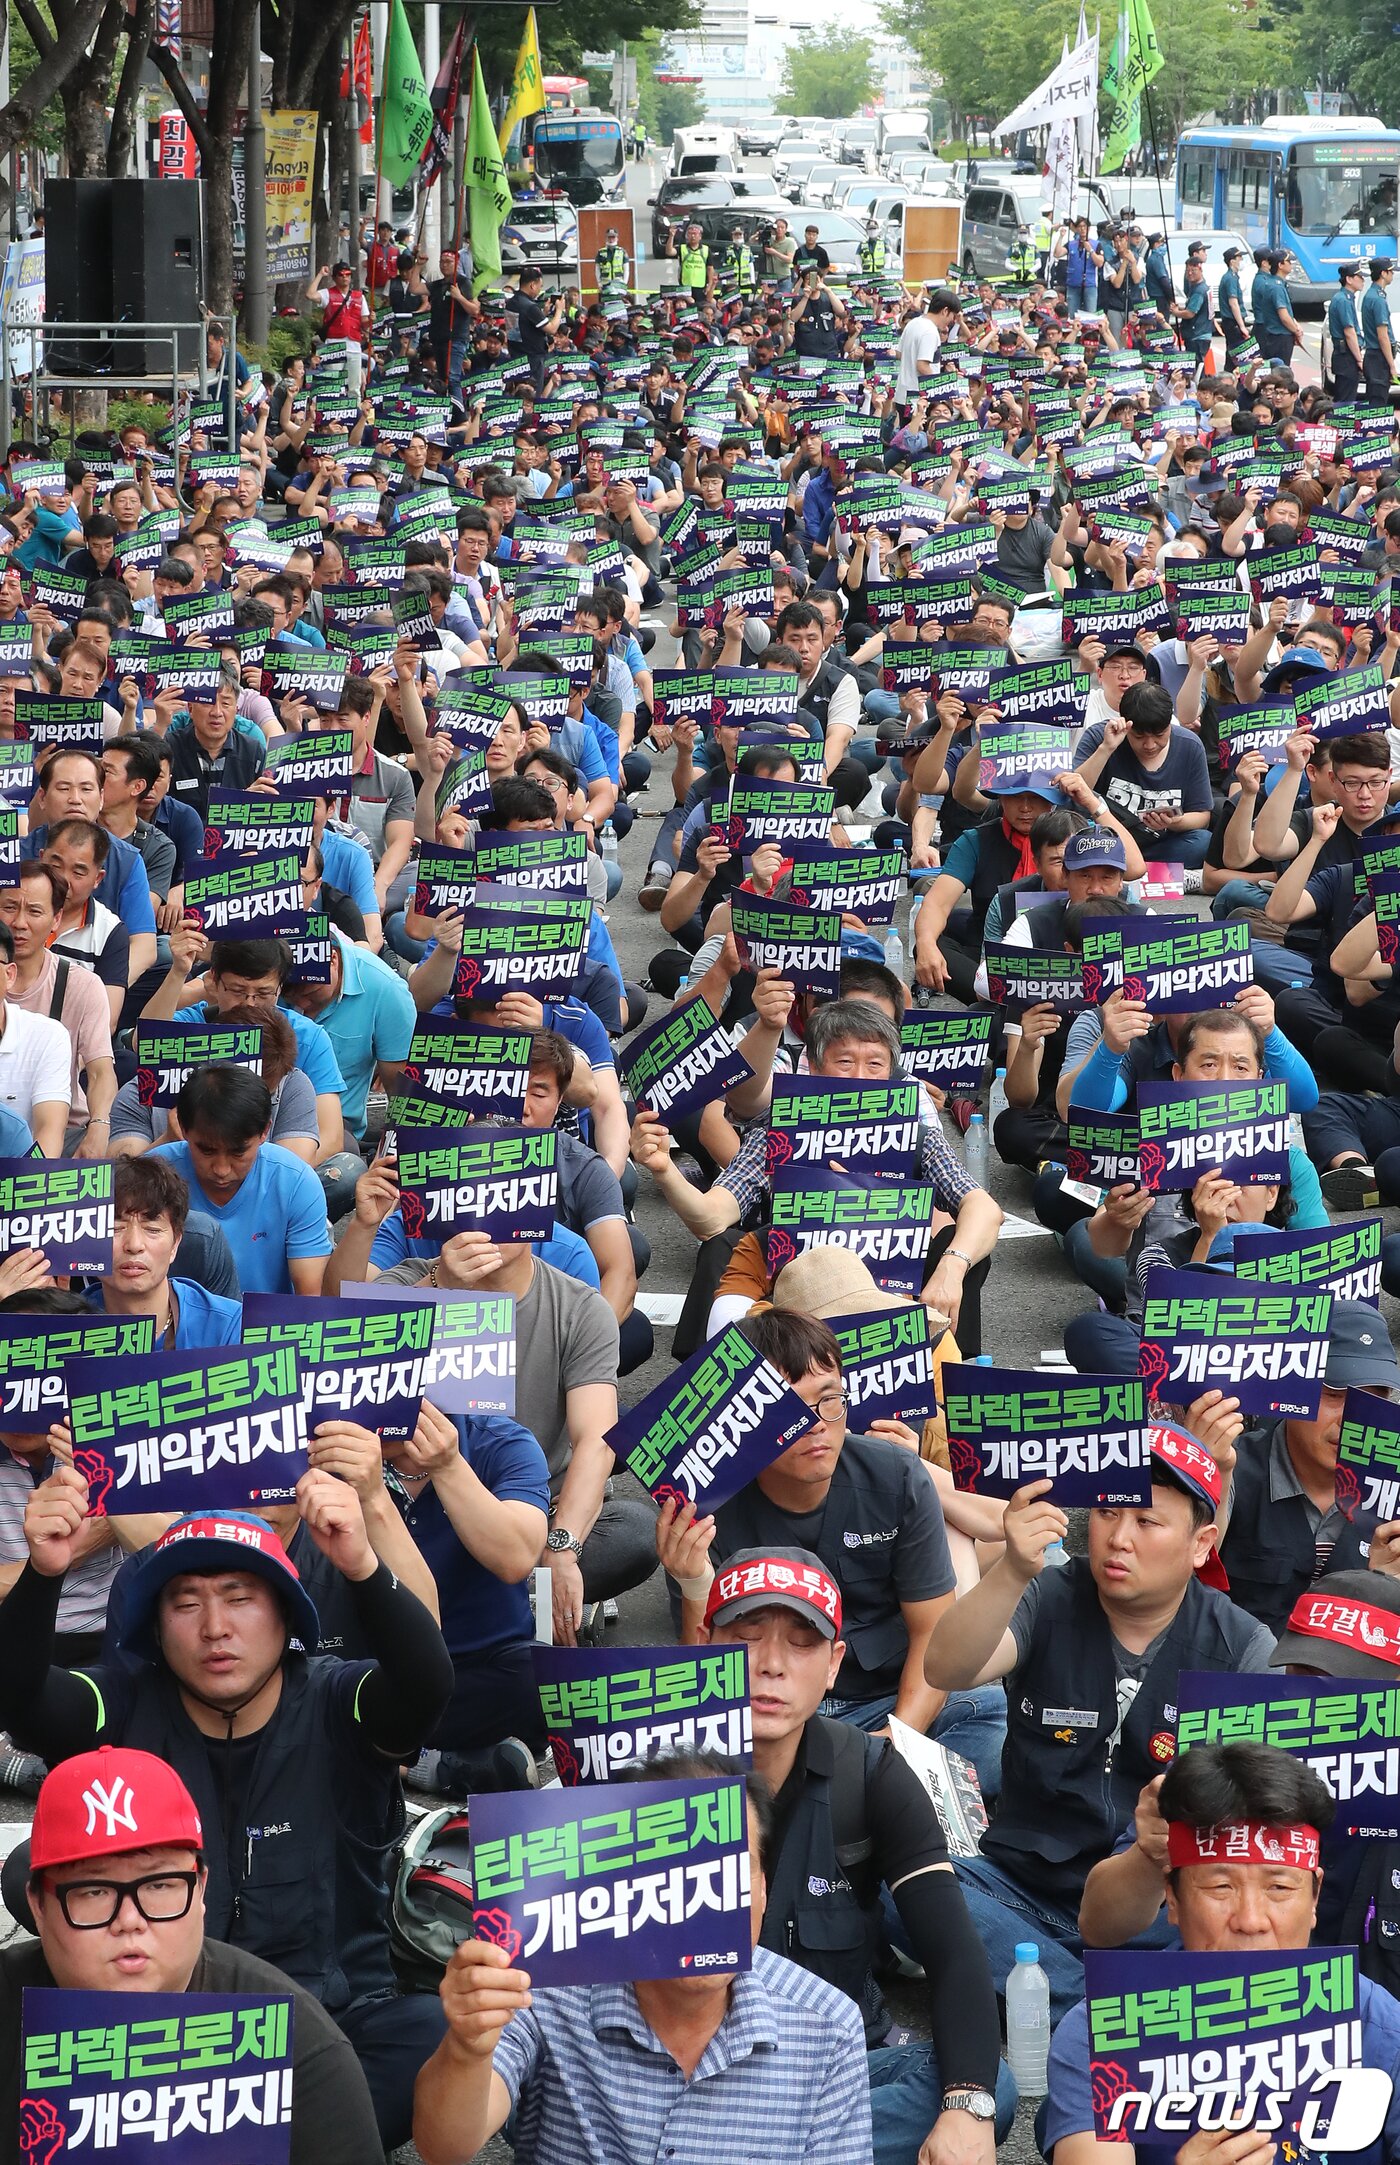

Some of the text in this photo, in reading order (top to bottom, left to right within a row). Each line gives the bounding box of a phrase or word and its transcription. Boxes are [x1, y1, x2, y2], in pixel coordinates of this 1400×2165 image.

[473, 156, 505, 183] 대구
[1343, 168, 1361, 178] 503
[1350, 244, 1376, 256] 대일
[1295, 427, 1337, 442] 노동탄압
[12, 462, 64, 481] 탄력근로제
[191, 454, 240, 468] 탄력근로제
[331, 492, 379, 504] 탄력근로제
[726, 483, 788, 498] 탄력근로제
[734, 497, 787, 516] 개악저지!
[514, 527, 571, 540] 탄력근로제
[1309, 514, 1374, 537] 탄력근로제
[519, 539, 567, 556] 개악저지!
[912, 530, 972, 559] 탄력근로제
[1313, 531, 1367, 552] 개악저지!
[920, 548, 977, 572] 개악저지!
[1248, 545, 1316, 577] 탄력근로제
[33, 569, 86, 592] 탄력근로제
[714, 569, 772, 594] 탄력근로제
[1261, 563, 1320, 592] 개악저지!
[35, 587, 85, 608] 개악저지!
[165, 590, 231, 622] 탄력근로제
[723, 586, 775, 611] 개악저지!
[1064, 595, 1137, 616] 탄력근로제
[1179, 595, 1249, 615] 탄력근로제
[176, 611, 234, 636] 개악저지!
[1074, 613, 1137, 633] 개악저지!
[1188, 613, 1248, 632] 개악저지!
[149, 652, 220, 672] 탄력근로제
[264, 653, 346, 672] 탄력근로제
[156, 671, 222, 690] 개악저지!
[274, 673, 344, 692] 개악저지!
[715, 676, 798, 696] 탄력근로제
[989, 661, 1071, 700] 탄력근로제
[1294, 667, 1382, 708] 탄력근로제
[16, 702, 102, 720] 탄력근로제
[436, 688, 510, 717] 탄력근로제
[726, 695, 797, 713] 개악저지!
[1002, 684, 1074, 716] 개악저지!
[1312, 693, 1388, 731] 개악저지!
[30, 722, 102, 742] 개악저지!
[435, 711, 502, 737] 개악저지!
[266, 738, 351, 766] 탄력근로제
[981, 732, 1069, 756] 탄력근로제
[276, 756, 352, 784] 개악저지!
[997, 752, 1072, 778] 개악저지!
[208, 802, 314, 825] 탄력근로제
[732, 792, 834, 813] 탄력근로제
[223, 827, 313, 851] 개악저지!
[746, 818, 831, 839] 개악저지!
[1076, 837, 1116, 854] Chicago
[186, 857, 298, 904] 탄력근로제
[794, 854, 901, 885] 탄력근로제
[205, 886, 304, 931] 개악저지!
[810, 880, 898, 910] 개악저지!
[464, 922, 583, 954] 탄력근로제
[734, 910, 839, 940] 탄력근로제
[748, 942, 841, 971] 개악저지!
[1123, 918, 1248, 972] 탄력근로제
[482, 953, 578, 984] 개악저지!
[1147, 956, 1253, 999] 개악저지!
[139, 1030, 260, 1064] 탄력근로제
[410, 1036, 531, 1064] 탄력근로제
[629, 1003, 715, 1099] 탄력근로제
[424, 1069, 529, 1097] 개악저지!
[646, 1029, 740, 1113] 개악저지!
[772, 1087, 917, 1126] 탄력근로제
[1140, 1085, 1286, 1130] 탄력근로제
[793, 1122, 919, 1160] 개악저지!
[1167, 1120, 1290, 1171] 개악저지!
[400, 1134, 555, 1185] 탄력근로제
[426, 1174, 557, 1221] 개악저지!
[773, 1188, 933, 1224] 탄력근로제
[78, 1263, 104, 1271] 민주노총
[888, 1280, 913, 1289] 민주노총
[1145, 1296, 1331, 1336] 탄력근로제
[1170, 1341, 1326, 1382] 개악저지!
[71, 1342, 298, 1441] 탄력근로제
[477, 1401, 506, 1409] 민주노총
[629, 1330, 753, 1485] 탄력근로제
[902, 1407, 928, 1417] 민주노총
[947, 1383, 1142, 1432] 탄력근로제
[1280, 1404, 1309, 1414] 민주노총
[383, 1427, 408, 1435] 민주노총
[674, 1361, 791, 1495] 개악저지!
[783, 1417, 808, 1442] 민주노총
[115, 1402, 308, 1488] 개악저지!
[982, 1429, 1153, 1481] 개악저지!
[1181, 1443, 1217, 1483] 투쟁
[719, 1562, 838, 1618] 단결 투쟁
[1308, 1602, 1360, 1637] 단결
[540, 1652, 744, 1727] 탄력근로제
[82, 1776, 138, 1836] NY
[264, 1821, 292, 1837] 금속노조
[475, 1788, 741, 1898] 탄력근로제
[1360, 1828, 1397, 1837] 민주노총
[1195, 1824, 1318, 1869] 단결 투쟁
[523, 1853, 752, 1957] 개악저지!
[694, 1952, 738, 1966] 민주노총
[1091, 1957, 1354, 2051] 탄력근로제
[25, 2004, 288, 2088] 탄력근로제
[68, 2070, 293, 2148] 개악저지!
